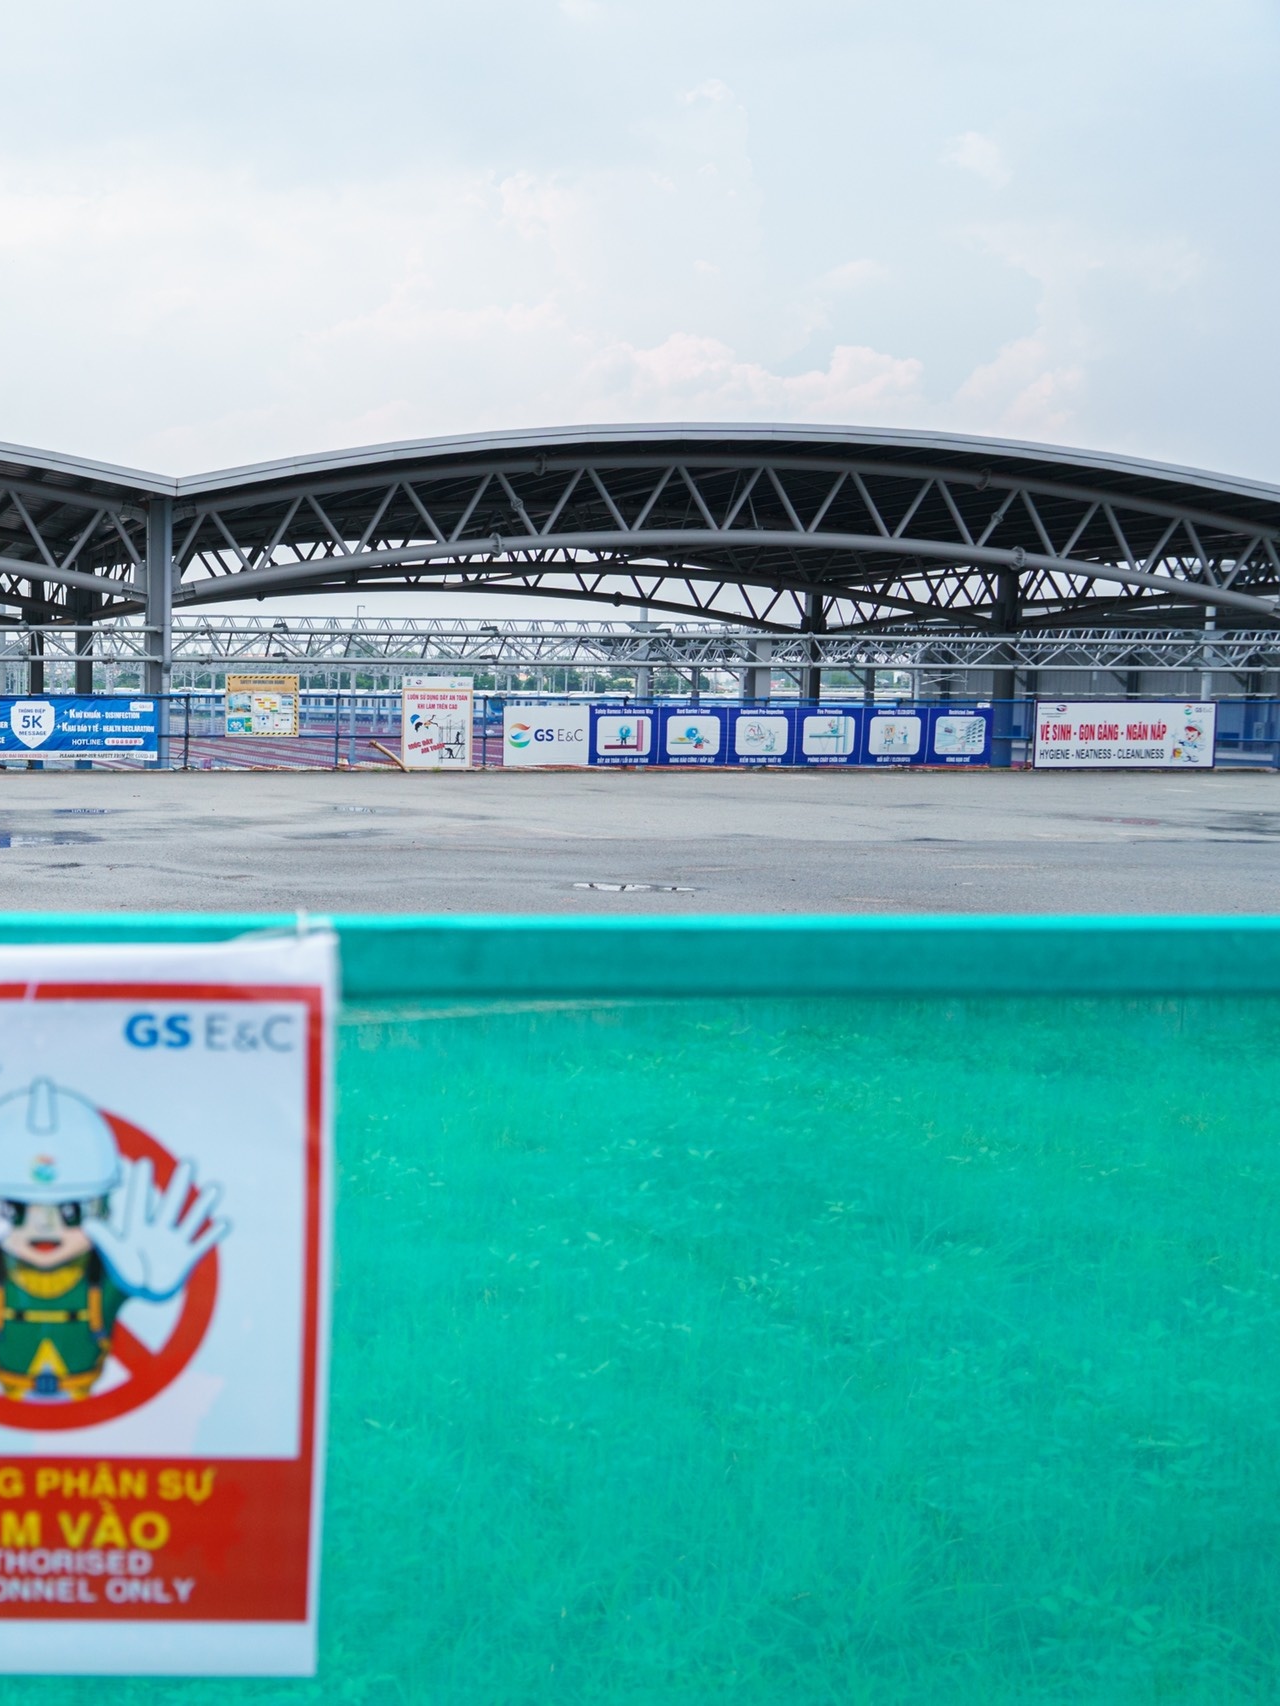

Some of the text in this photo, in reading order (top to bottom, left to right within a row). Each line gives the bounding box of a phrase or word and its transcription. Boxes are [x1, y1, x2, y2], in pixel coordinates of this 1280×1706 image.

[22, 716, 42, 728] 5K
[1040, 721, 1050, 744] VỆ
[1052, 724, 1072, 741] SINH
[1079, 724, 1096, 744] GỌN
[1098, 721, 1119, 741] GÀNG
[1126, 721, 1148, 741] NGĂN
[1150, 719, 1167, 741] NẮP
[534, 729, 583, 742] GS E&C
[1040, 749, 1070, 760] HYGIENE
[1075, 749, 1112, 759] NEATNESS
[1117, 748, 1164, 759] CLEANLINESS
[125, 1013, 294, 1052] GS E&C
[158, 1465, 217, 1505] SỰ
[57, 1499, 170, 1550] VÀO
[105, 1577, 195, 1603] ONLY
